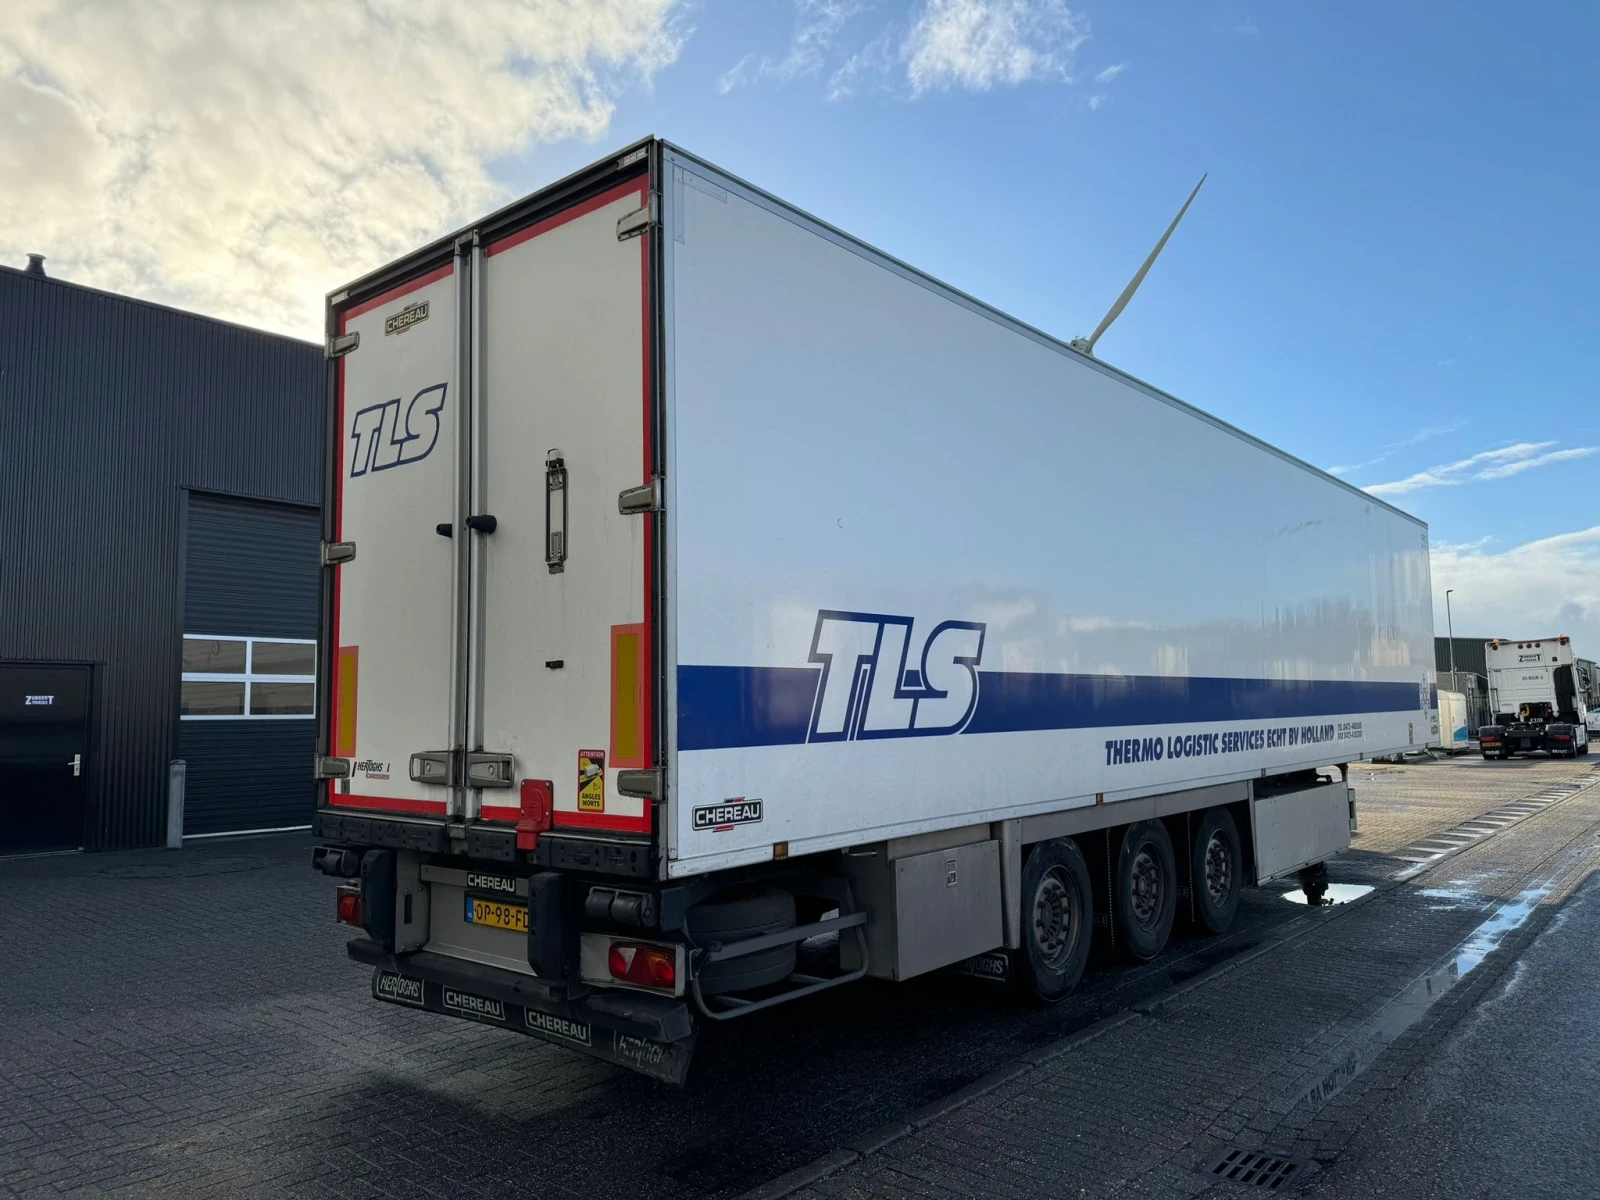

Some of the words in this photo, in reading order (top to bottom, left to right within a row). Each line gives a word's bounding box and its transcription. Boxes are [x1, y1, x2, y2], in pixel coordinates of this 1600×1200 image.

[387, 304, 428, 332] CHEREAU
[351, 382, 448, 478] TLS
[807, 609, 987, 744] TLS
[1105, 737, 1164, 766] THERMO
[1167, 733, 1219, 759] LOGISTIC
[1221, 729, 1265, 753] SERVICES
[1267, 728, 1287, 748] ECHT
[1289, 727, 1300, 746] BV
[1301, 724, 1335, 744] HOLLAND
[695, 804, 760, 825] CHEREAU
[468, 874, 515, 892] CHEREAU
[446, 991, 500, 1015] CHEREAU
[528, 1011, 586, 1040] CHEREAU
